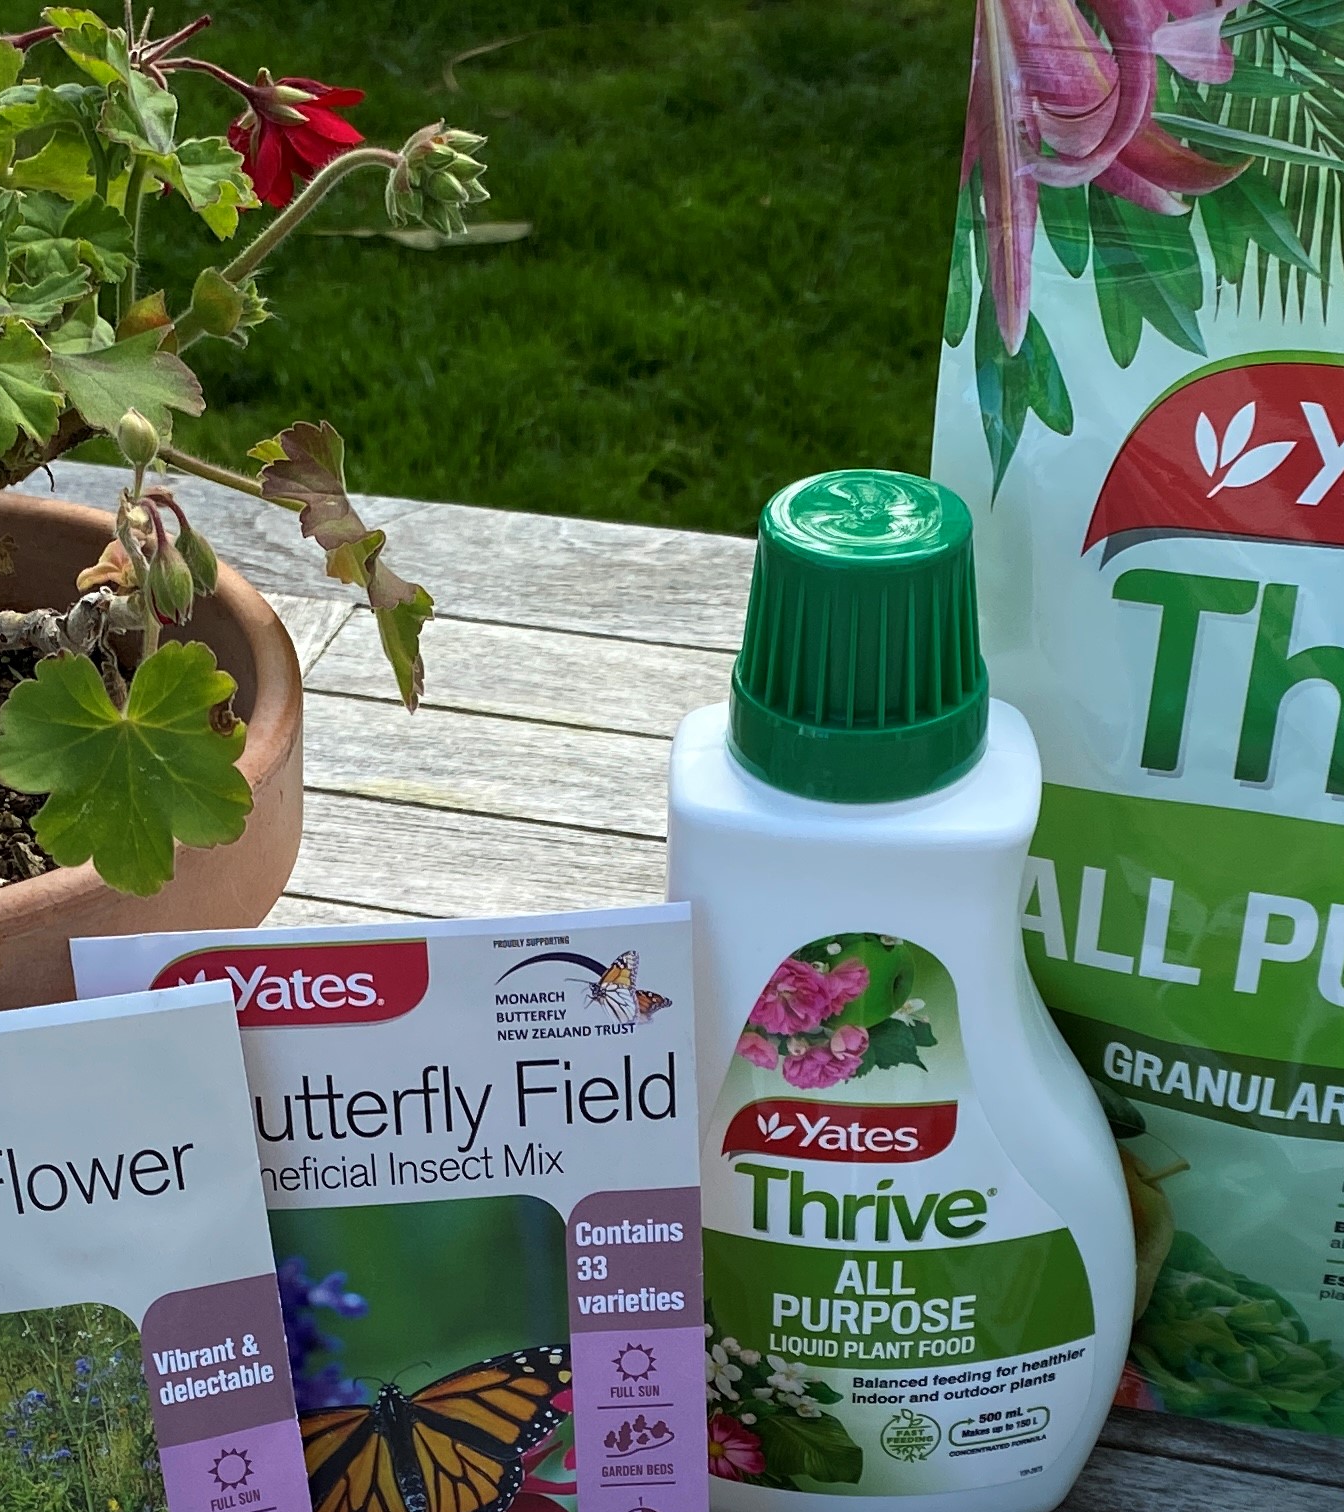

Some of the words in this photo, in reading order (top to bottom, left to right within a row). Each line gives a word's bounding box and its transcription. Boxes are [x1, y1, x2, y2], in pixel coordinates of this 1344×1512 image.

[1020, 855, 1201, 987] ALL
[225, 965, 378, 1012] Yates
[495, 990, 565, 1006] MONARCH
[496, 1009, 567, 1023] BUTTERFLY
[497, 1027, 530, 1041] NEW
[532, 1025, 593, 1039] ZEALAND
[596, 1023, 636, 1037] TRUST
[255, 1066, 493, 1152] utterfly
[516, 1051, 677, 1127] Field
[795, 1113, 919, 1154] Yates
[260, 1152, 378, 1191] neficial
[389, 1146, 494, 1184] Insect
[505, 1142, 565, 1177] Mix
[734, 1162, 988, 1243] Thrive
[575, 1219, 684, 1247] Contains
[577, 1256, 608, 1281] 33
[834, 1259, 916, 1296] ALL
[578, 1286, 685, 1315] varieties
[772, 1293, 977, 1336] PURPOSE
[152, 1337, 236, 1377] Vibrant
[242, 1333, 260, 1355] &
[769, 1333, 839, 1358] LIQUID
[843, 1341, 914, 1360] PLANT
[918, 1335, 976, 1359] FOOD
[159, 1363, 275, 1406] delectable
[853, 1375, 928, 1389] Balanced
[933, 1369, 992, 1387] feeding
[997, 1364, 1018, 1378] for
[1022, 1347, 1086, 1374] healthier
[909, 1390, 939, 1403] and
[944, 1382, 1006, 1401] outdoor
[1010, 1371, 1056, 1394] plants
[979, 1411, 1002, 1424] 500
[1006, 1407, 1023, 1419] mL
